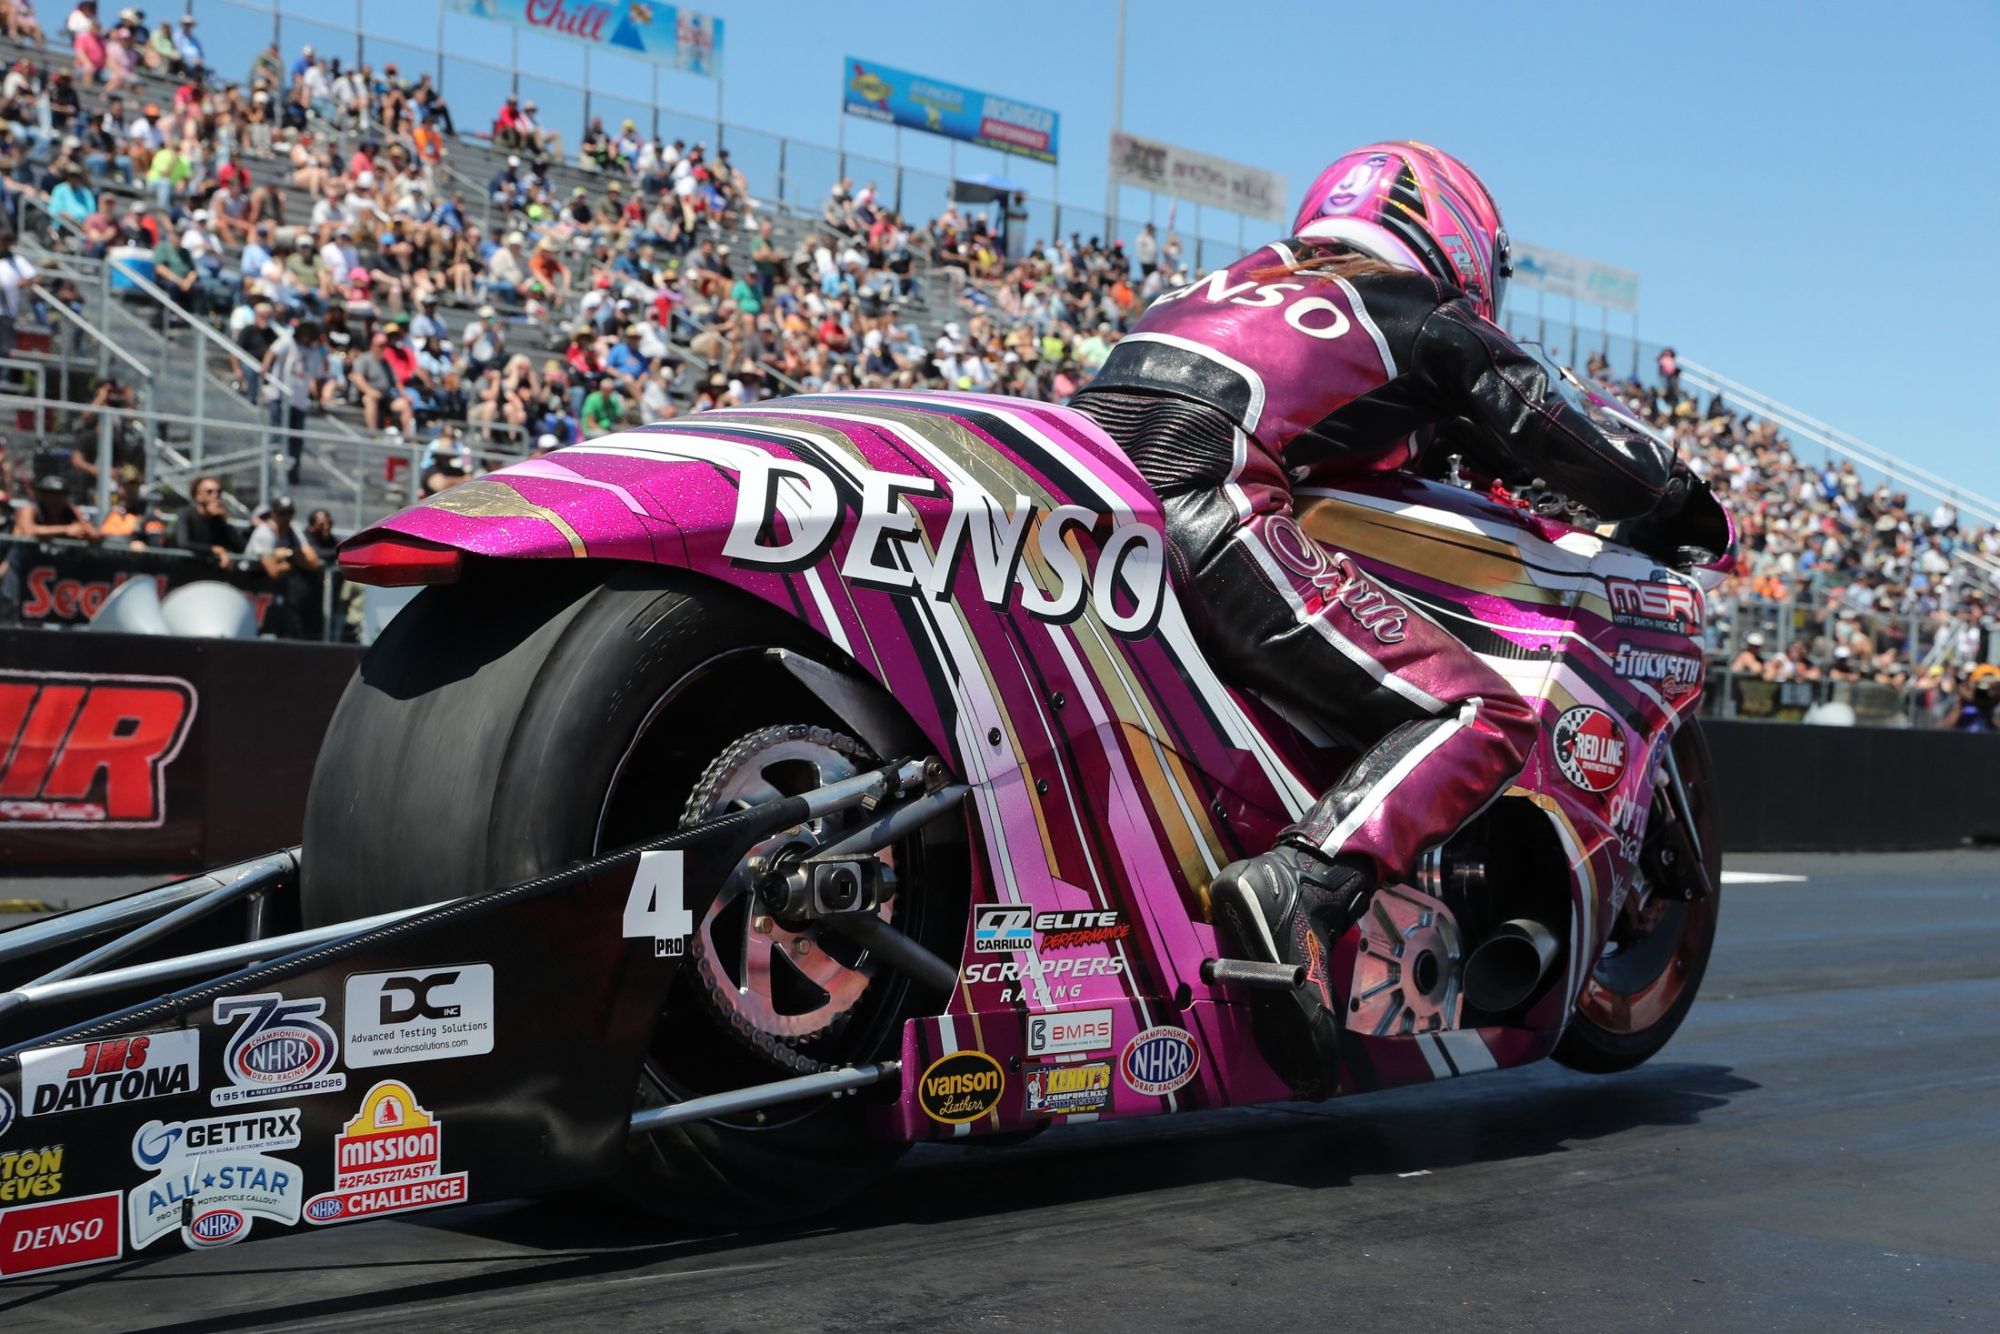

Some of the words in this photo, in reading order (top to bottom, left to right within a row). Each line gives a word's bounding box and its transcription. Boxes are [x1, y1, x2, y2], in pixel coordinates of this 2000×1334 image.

[721, 456, 1166, 633] DENSO
[1608, 580, 1695, 622] MSR
[1655, 619, 1678, 632] RACING
[0, 683, 186, 818] IR
[1575, 731, 1600, 761] RED
[1600, 737, 1625, 767] LINE
[622, 849, 693, 938] 4
[977, 910, 1031, 939] CP
[1035, 911, 1118, 930] ELITE
[656, 937, 683, 955] PRO
[976, 938, 1032, 951] CARRILLO
[1041, 924, 1131, 953] PERFORMANCE
[962, 956, 1126, 984] SCRAPPERS
[380, 971, 461, 1025] DC
[1000, 983, 1082, 1003] RACING
[443, 1007, 459, 1016] INC
[218, 998, 335, 1081] 75
[251, 1030, 307, 1047] CHAMPIONSHIP
[351, 1030, 395, 1044] Advanced
[400, 1026, 437, 1039] Testing
[442, 1021, 488, 1034] Solutions
[1052, 1022, 1109, 1040] BMRS
[1135, 1028, 1188, 1046] CHAMPIONSHIP
[67, 1036, 150, 1079] JMS
[252, 1039, 309, 1071] NHRA
[372, 1038, 469, 1057] www.dcincsolutions.com
[1134, 1040, 1189, 1081] NHRA
[251, 1071, 273, 1082] DRAG
[277, 1066, 307, 1081] RACING
[926, 1070, 998, 1097] vanson
[1134, 1080, 1154, 1092] DRAG
[1157, 1075, 1185, 1093] RACING
[32, 1063, 190, 1115] DAYTONA
[215, 1089, 246, 1102] 1951
[249, 1083, 310, 1097] ANNIVERSARY
[313, 1078, 343, 1089] 2026
[939, 1094, 985, 1115] Leathers
[186, 1114, 297, 1149] GETTRX
[265, 1138, 297, 1148] TECHNOLOGY
[0, 1146, 64, 1180] TON
[338, 1163, 437, 1190] #2FAST2TASTY
[0, 1172, 63, 1201] EVES
[148, 1174, 200, 1216] ALL
[219, 1165, 290, 1196] STAR
[311, 1199, 343, 1218] NHRA
[347, 1179, 461, 1214] CHALLENGE
[156, 1211, 172, 1223] PRO
[198, 1194, 246, 1206] MOTORCYCLE
[246, 1194, 278, 1206] CALLOUT
[12, 1217, 104, 1253] DENSO
[199, 1214, 237, 1236] NHRA
